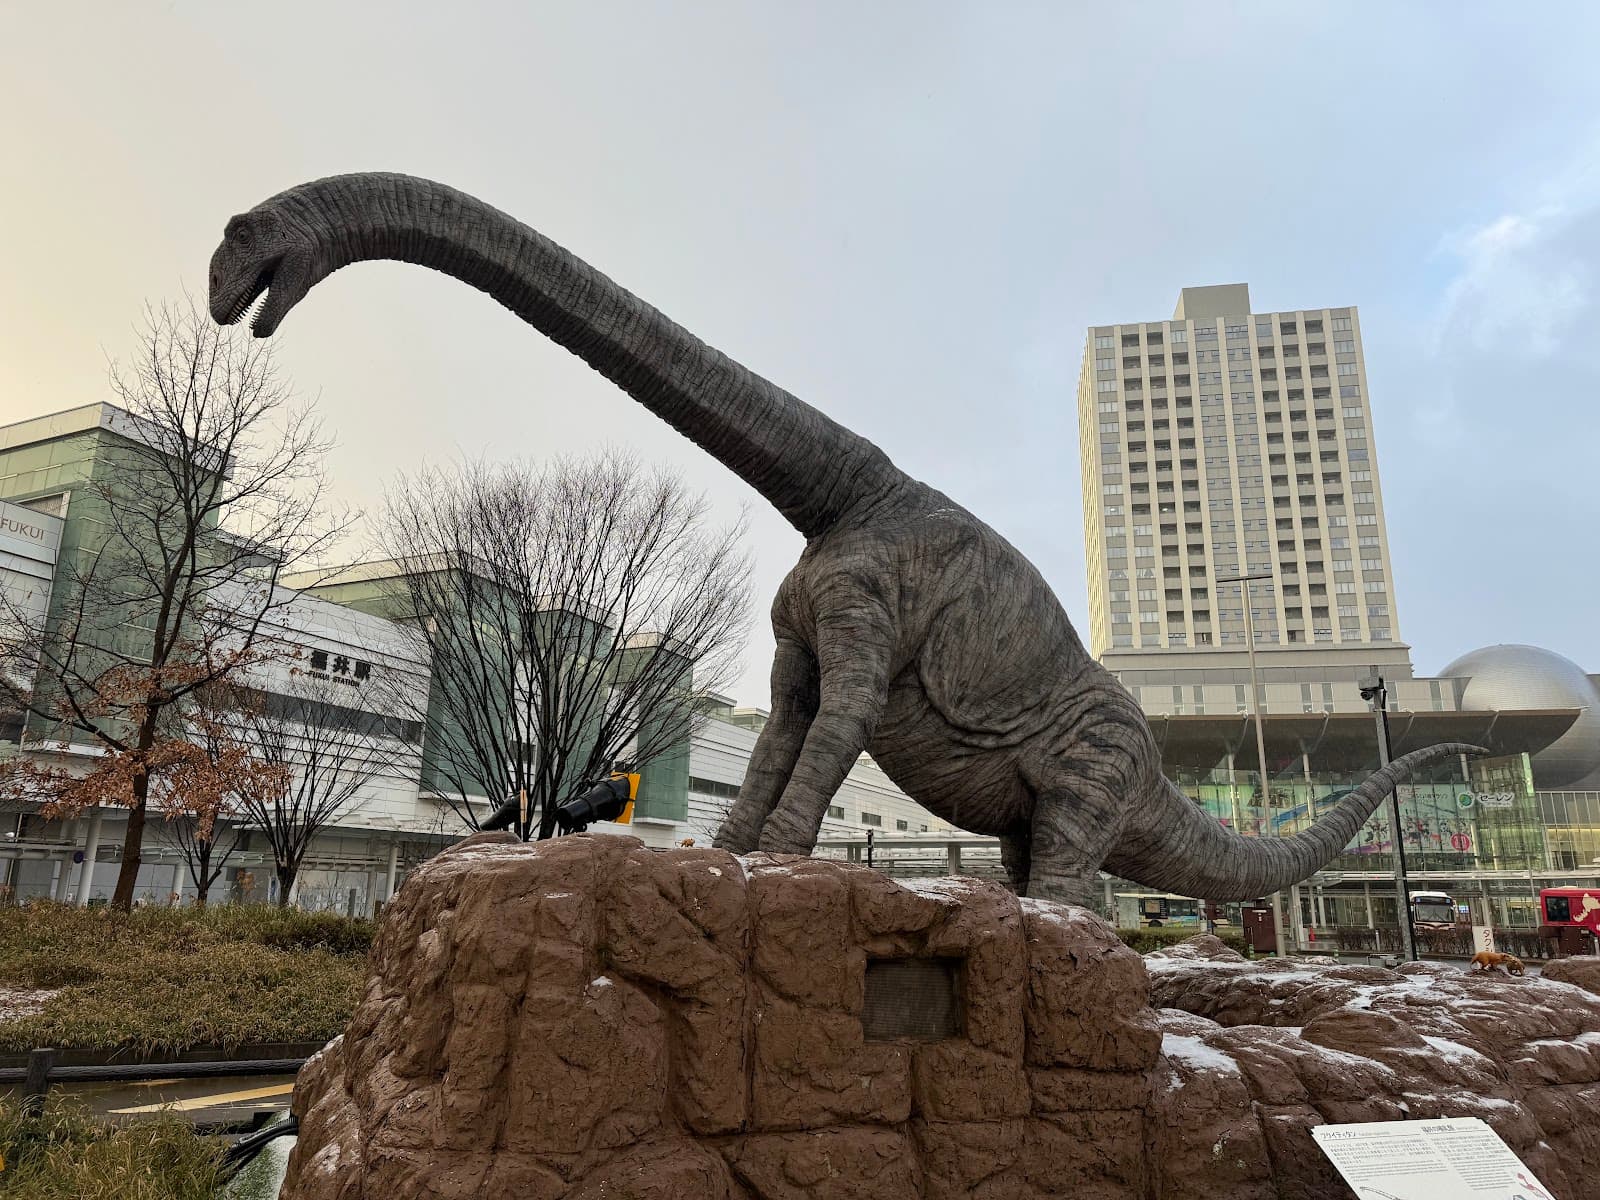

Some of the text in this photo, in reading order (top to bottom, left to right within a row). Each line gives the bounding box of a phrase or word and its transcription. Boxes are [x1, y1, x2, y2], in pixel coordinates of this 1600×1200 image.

[0, 518, 44, 541] FUKUI
[308, 670, 360, 688] FUKUI STATION
